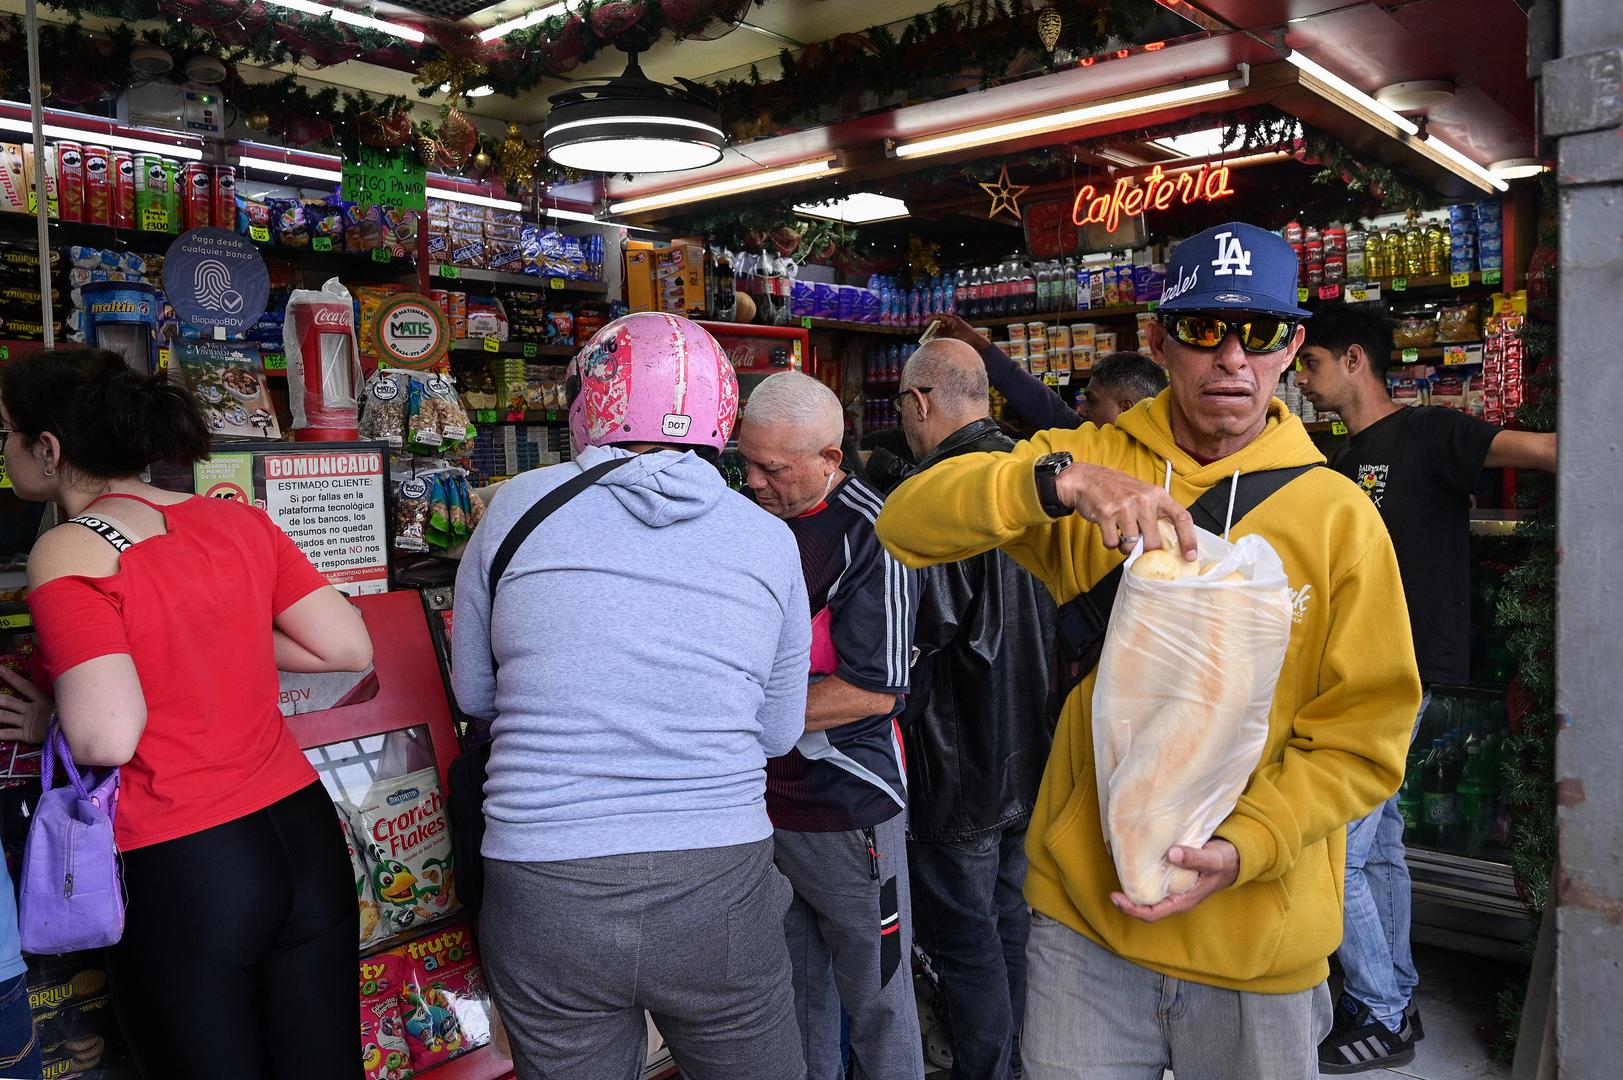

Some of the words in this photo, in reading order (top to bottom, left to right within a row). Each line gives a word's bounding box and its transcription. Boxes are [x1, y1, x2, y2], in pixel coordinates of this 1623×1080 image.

[344, 174, 386, 192] TRIGO
[192, 234, 214, 245] Paga
[216, 238, 243, 248] desde
[182, 246, 224, 256] cualquier
[226, 250, 252, 260] banco
[1211, 231, 1253, 276] LA
[390, 322, 433, 338] MATIS
[667, 421, 686, 430] DOT
[270, 455, 379, 477] COMUNICADO
[278, 480, 329, 491] ESTIMADO
[332, 478, 373, 488] CLIENTE:
[290, 494, 299, 503] Si
[302, 494, 316, 504] por
[318, 492, 341, 501] fallas
[343, 492, 353, 500] en
[356, 491, 364, 499] la
[278, 505, 325, 516] plataforma
[328, 502, 374, 512] tecnológica
[289, 517, 300, 526] de
[302, 516, 316, 525] los
[354, 513, 366, 521] los
[329, 526, 340, 534] no
[342, 524, 373, 534] quedan
[293, 538, 324, 549] lejados
[326, 537, 338, 545] en
[340, 534, 376, 544] nuestros
[310, 549, 321, 558] de
[324, 546, 346, 556] venta
[349, 545, 362, 554] NO
[364, 544, 380, 552] nos
[321, 555, 379, 568] responsables.
[372, 790, 444, 842] Cronch
[390, 816, 446, 858] Flakes
[408, 930, 464, 960] fruty
[28, 983, 73, 1010] ARILU
